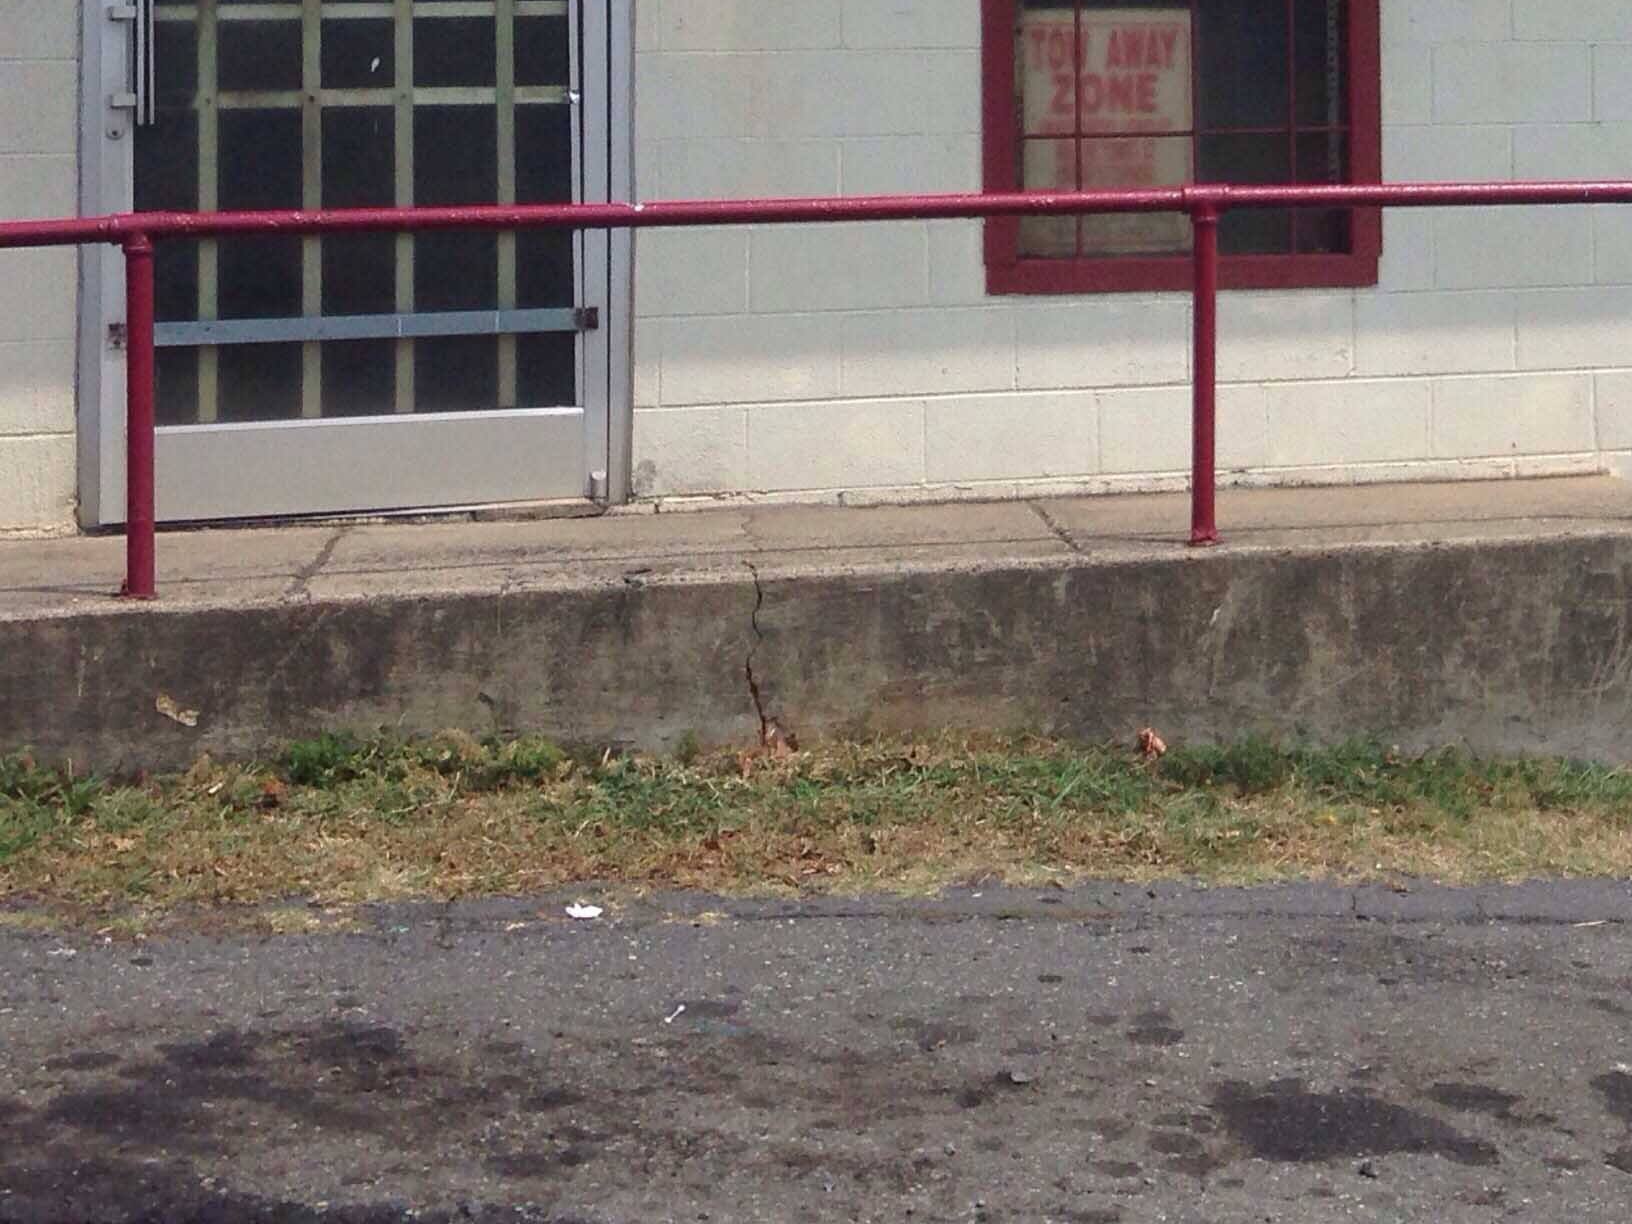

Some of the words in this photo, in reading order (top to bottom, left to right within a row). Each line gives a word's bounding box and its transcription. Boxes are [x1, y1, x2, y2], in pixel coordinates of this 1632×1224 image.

[1031, 28, 1089, 69] TOW
[1106, 28, 1177, 68] AWAY
[1050, 73, 1158, 114] ZONE
